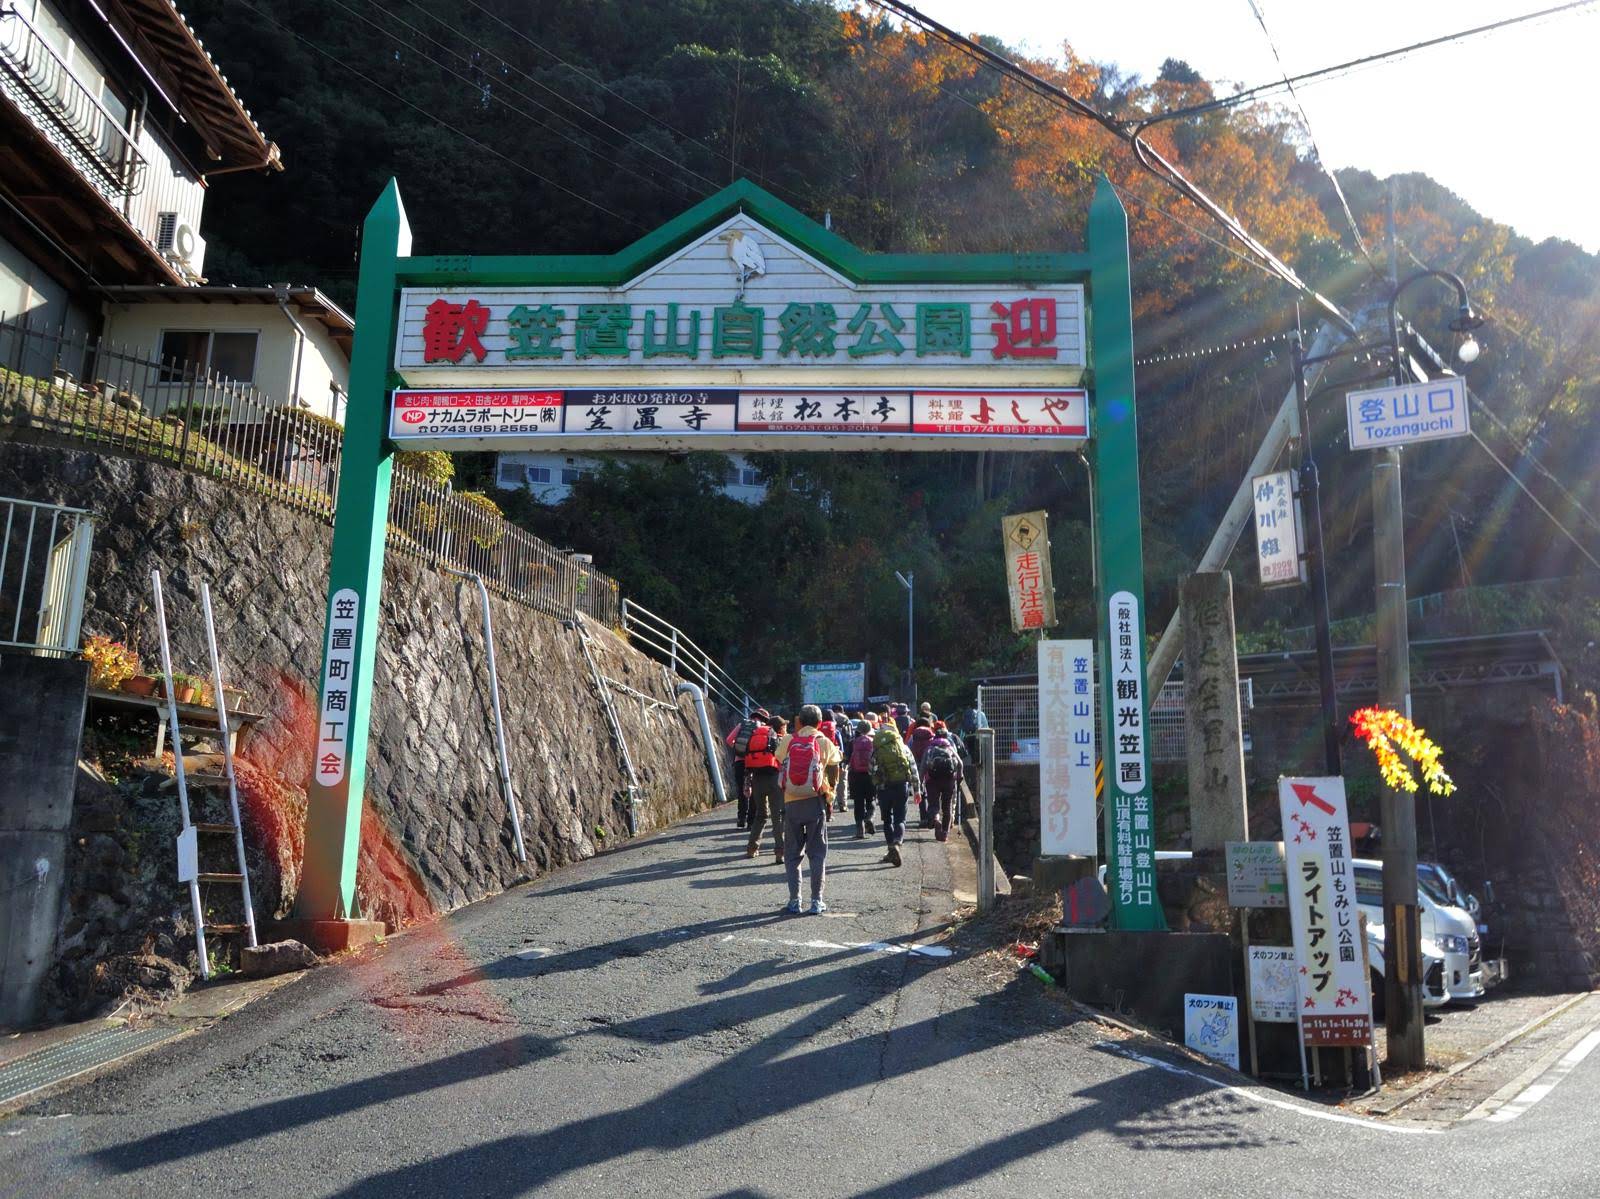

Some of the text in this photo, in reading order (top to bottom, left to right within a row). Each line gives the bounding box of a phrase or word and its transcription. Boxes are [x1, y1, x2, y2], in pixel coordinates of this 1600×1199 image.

[991, 298, 1058, 359] 迎
[592, 392, 709, 404] お水取り発祥の寺
[937, 425, 959, 433] TEL
[970, 397, 1070, 425] よしや
[1359, 389, 1454, 423] 登山口
[1364, 415, 1453, 438] Tozanguchi
[1017, 552, 1044, 627] 走行注意
[320, 599, 355, 775] 笠置町商工会
[1074, 657, 1091, 767] 笠置山山上
[1117, 602, 1142, 782] 一般社団法人 観光笠置
[1134, 795, 1152, 905] 笠置山登山口
[1302, 861, 1332, 993] ライトアップ
[1327, 826, 1355, 962] 笠置山もみじ公園
